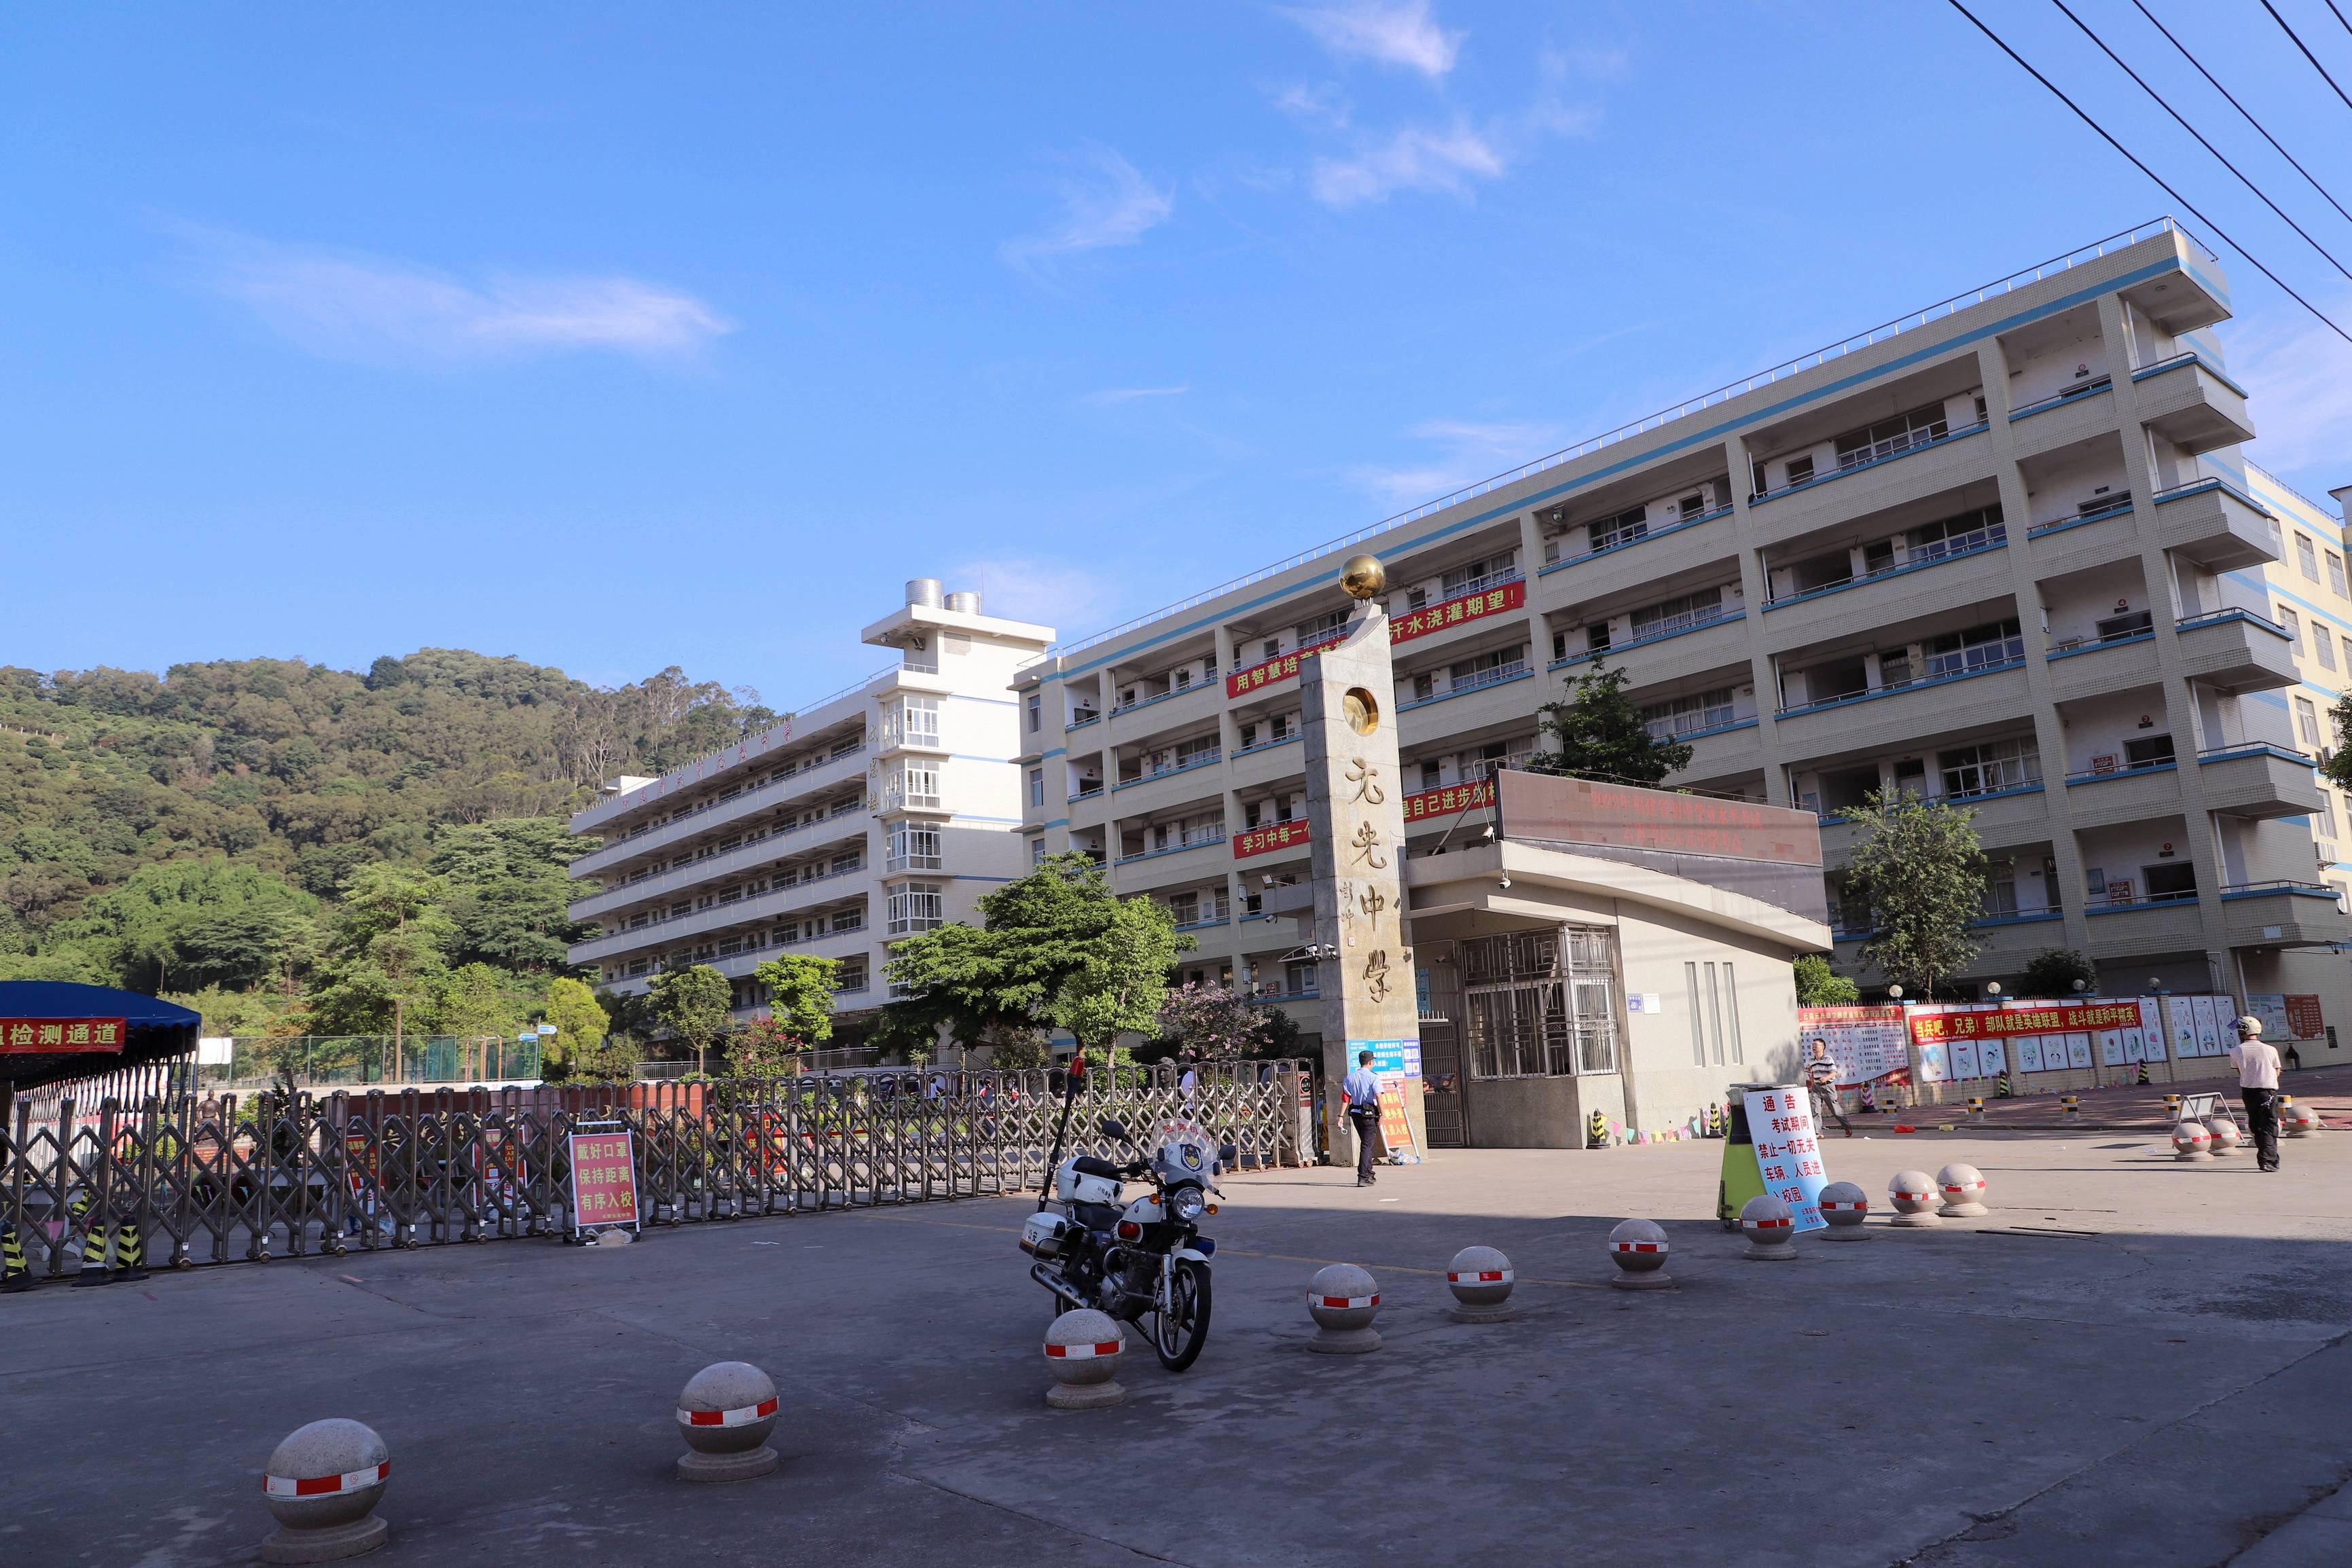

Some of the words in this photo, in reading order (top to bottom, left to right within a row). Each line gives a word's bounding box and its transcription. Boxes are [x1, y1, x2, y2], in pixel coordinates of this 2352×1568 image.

[1236, 640, 1347, 691] 用智慧培
[1389, 589, 1515, 642] 汗水浇灌期望！
[1345, 756, 1392, 1004] 元光中学
[0, 1023, 117, 1046] 检测通道
[1771, 1114, 1810, 1133] 考试期间
[576, 1142, 628, 1161] 戴好口罩
[1758, 1137, 1815, 1159] 禁止一切无关
[579, 1165, 630, 1185] 保持距离
[1765, 1159, 1822, 1182] 车辆、人员进
[581, 1190, 632, 1211] 有序入校
[1027, 1229, 1038, 1242] 公安
